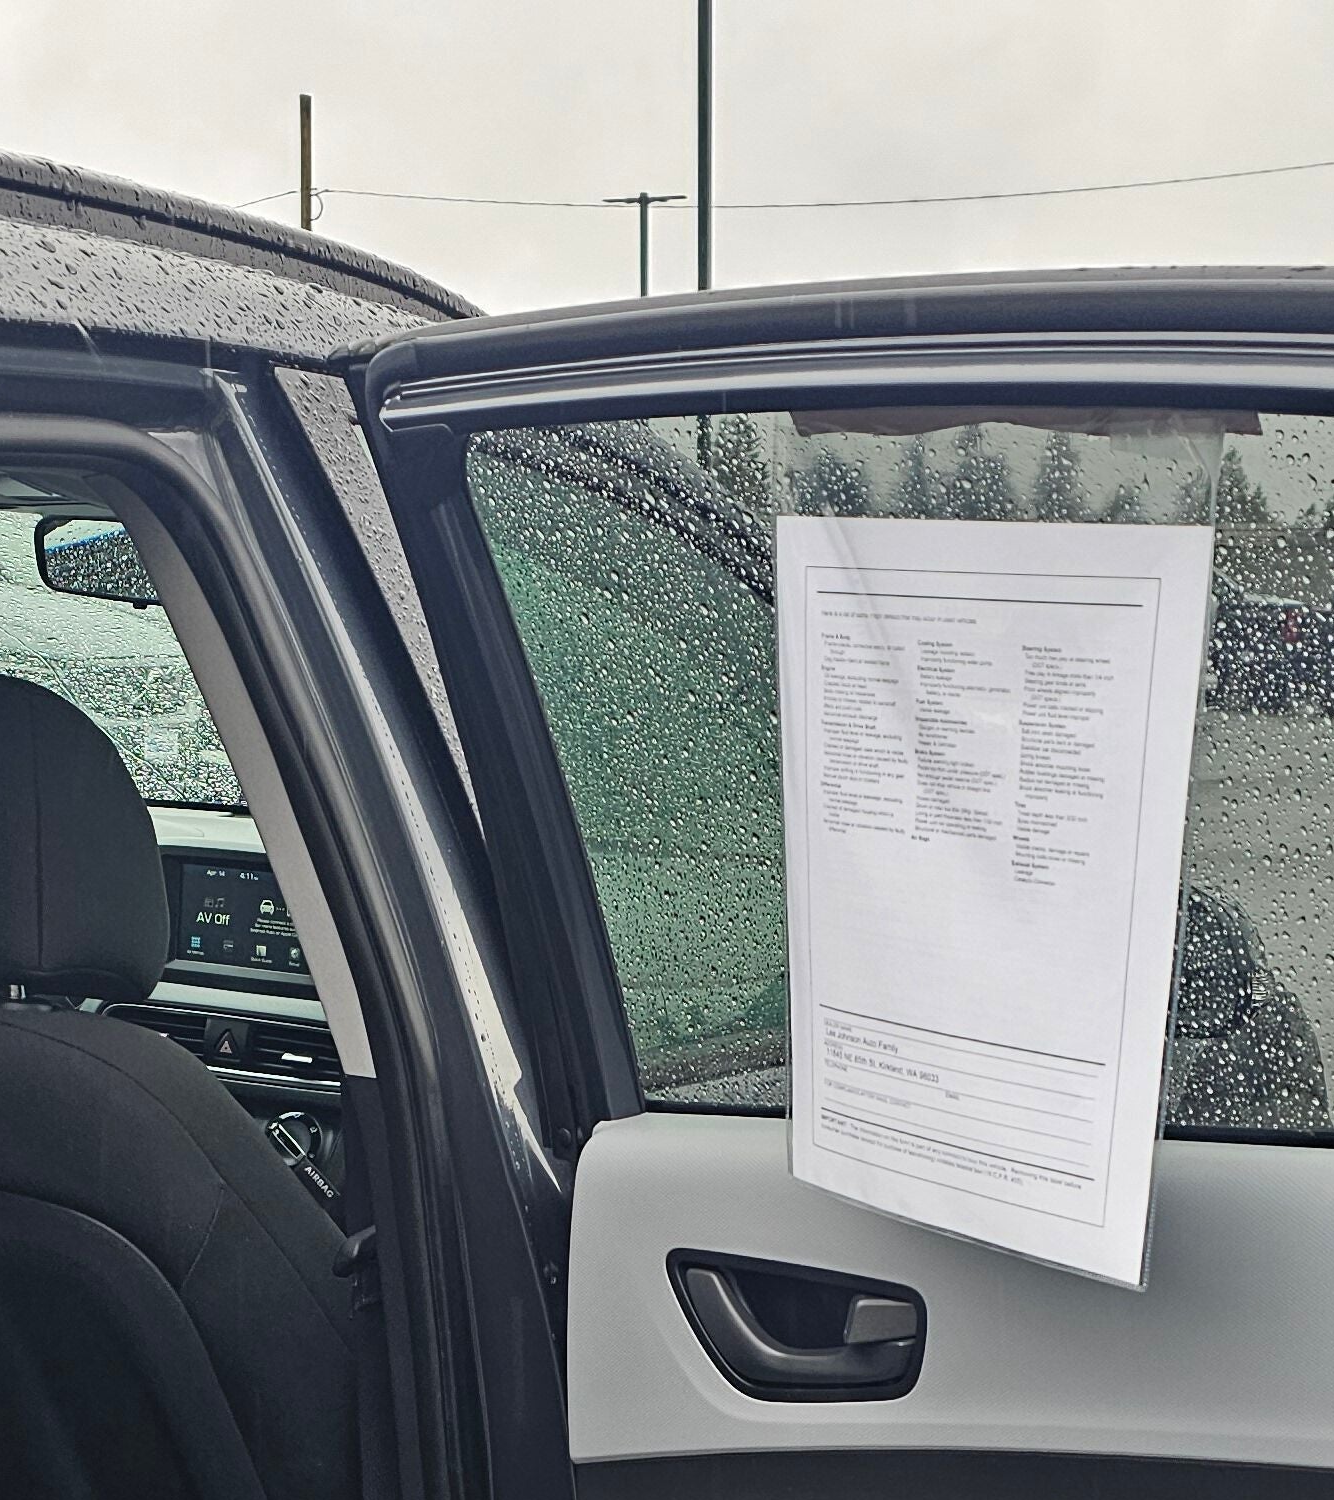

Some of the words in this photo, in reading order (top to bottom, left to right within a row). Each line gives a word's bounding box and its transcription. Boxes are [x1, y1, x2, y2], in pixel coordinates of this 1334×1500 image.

[196, 912, 212, 924] AV
[215, 913, 231, 926] Off
[879, 1041, 899, 1054] Family
[304, 1166, 334, 1198] AIRBAG
